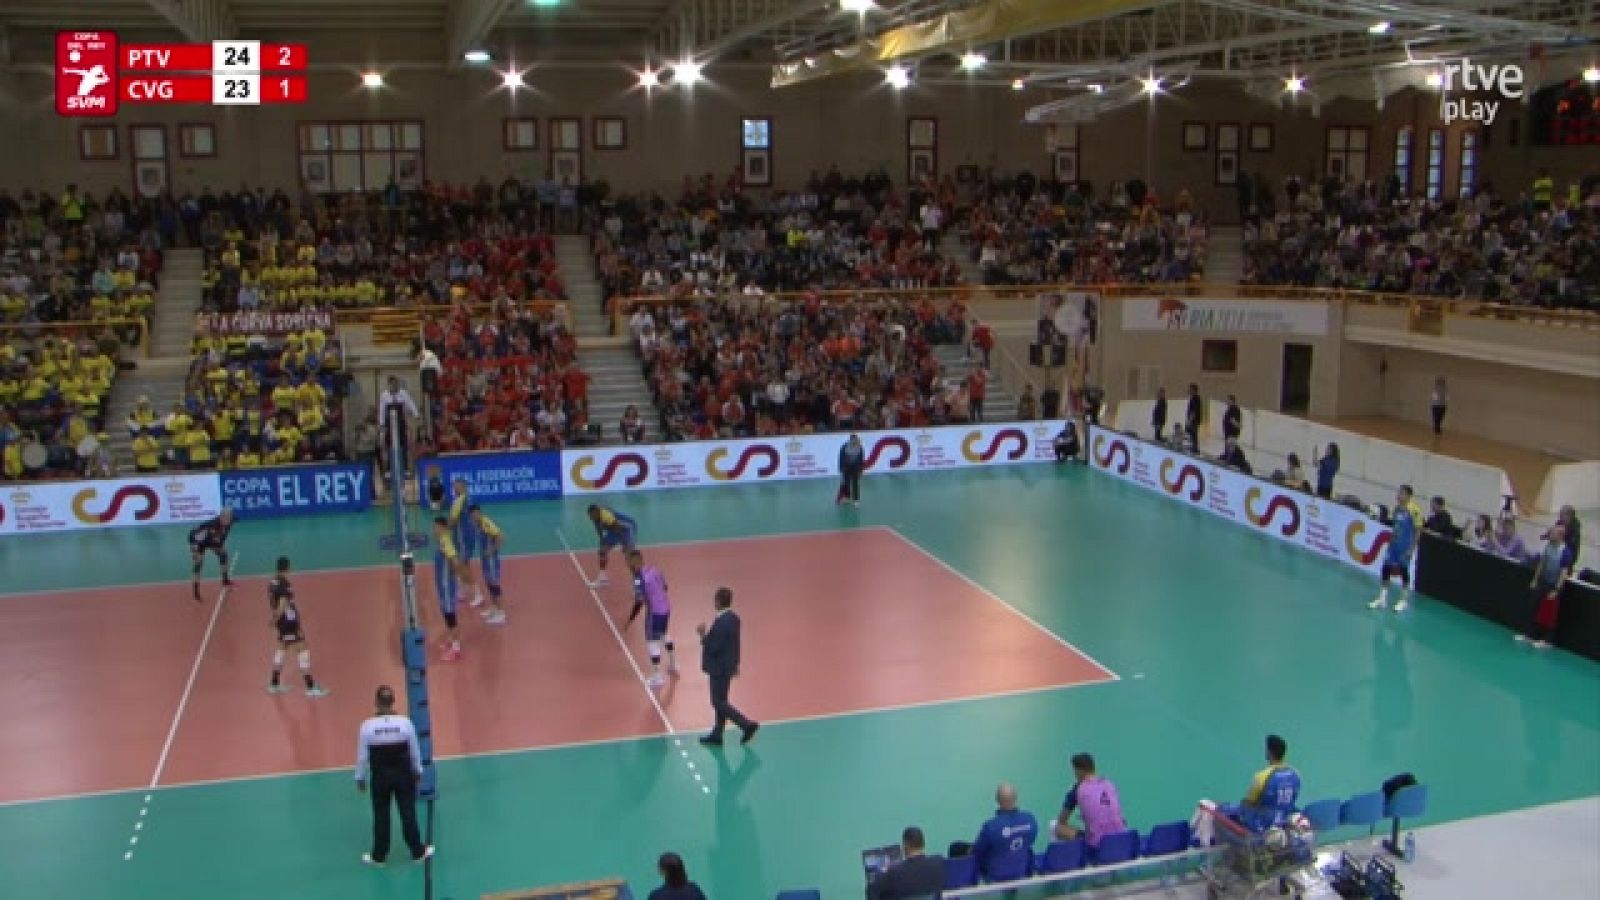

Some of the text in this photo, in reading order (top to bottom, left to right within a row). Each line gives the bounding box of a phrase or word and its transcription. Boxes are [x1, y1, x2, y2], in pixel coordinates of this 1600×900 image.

[224, 476, 271, 494] COPA
[278, 470, 366, 506] EL REY
